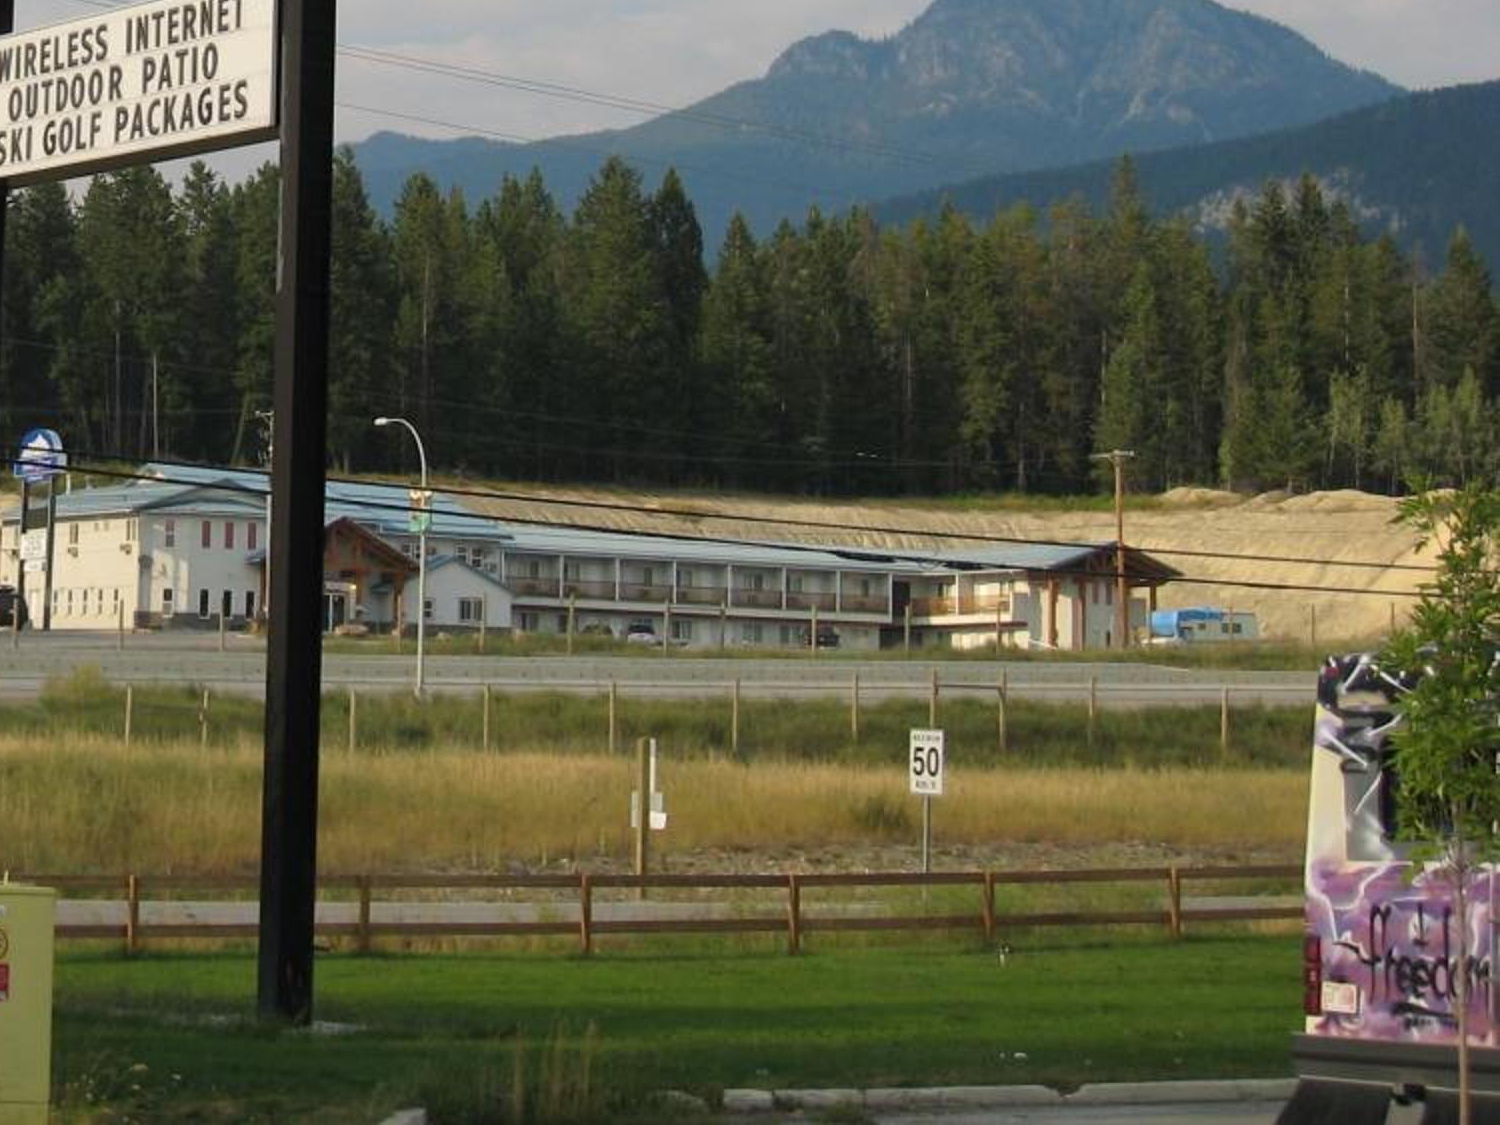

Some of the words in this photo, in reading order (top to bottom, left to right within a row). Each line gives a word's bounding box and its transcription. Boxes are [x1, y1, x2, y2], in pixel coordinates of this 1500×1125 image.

[8, 64, 123, 122] OUTDOOR
[142, 42, 219, 95] PATIO
[42, 110, 102, 156] GOLF
[114, 79, 249, 143] PACKAGES
[913, 746, 939, 777] 50
